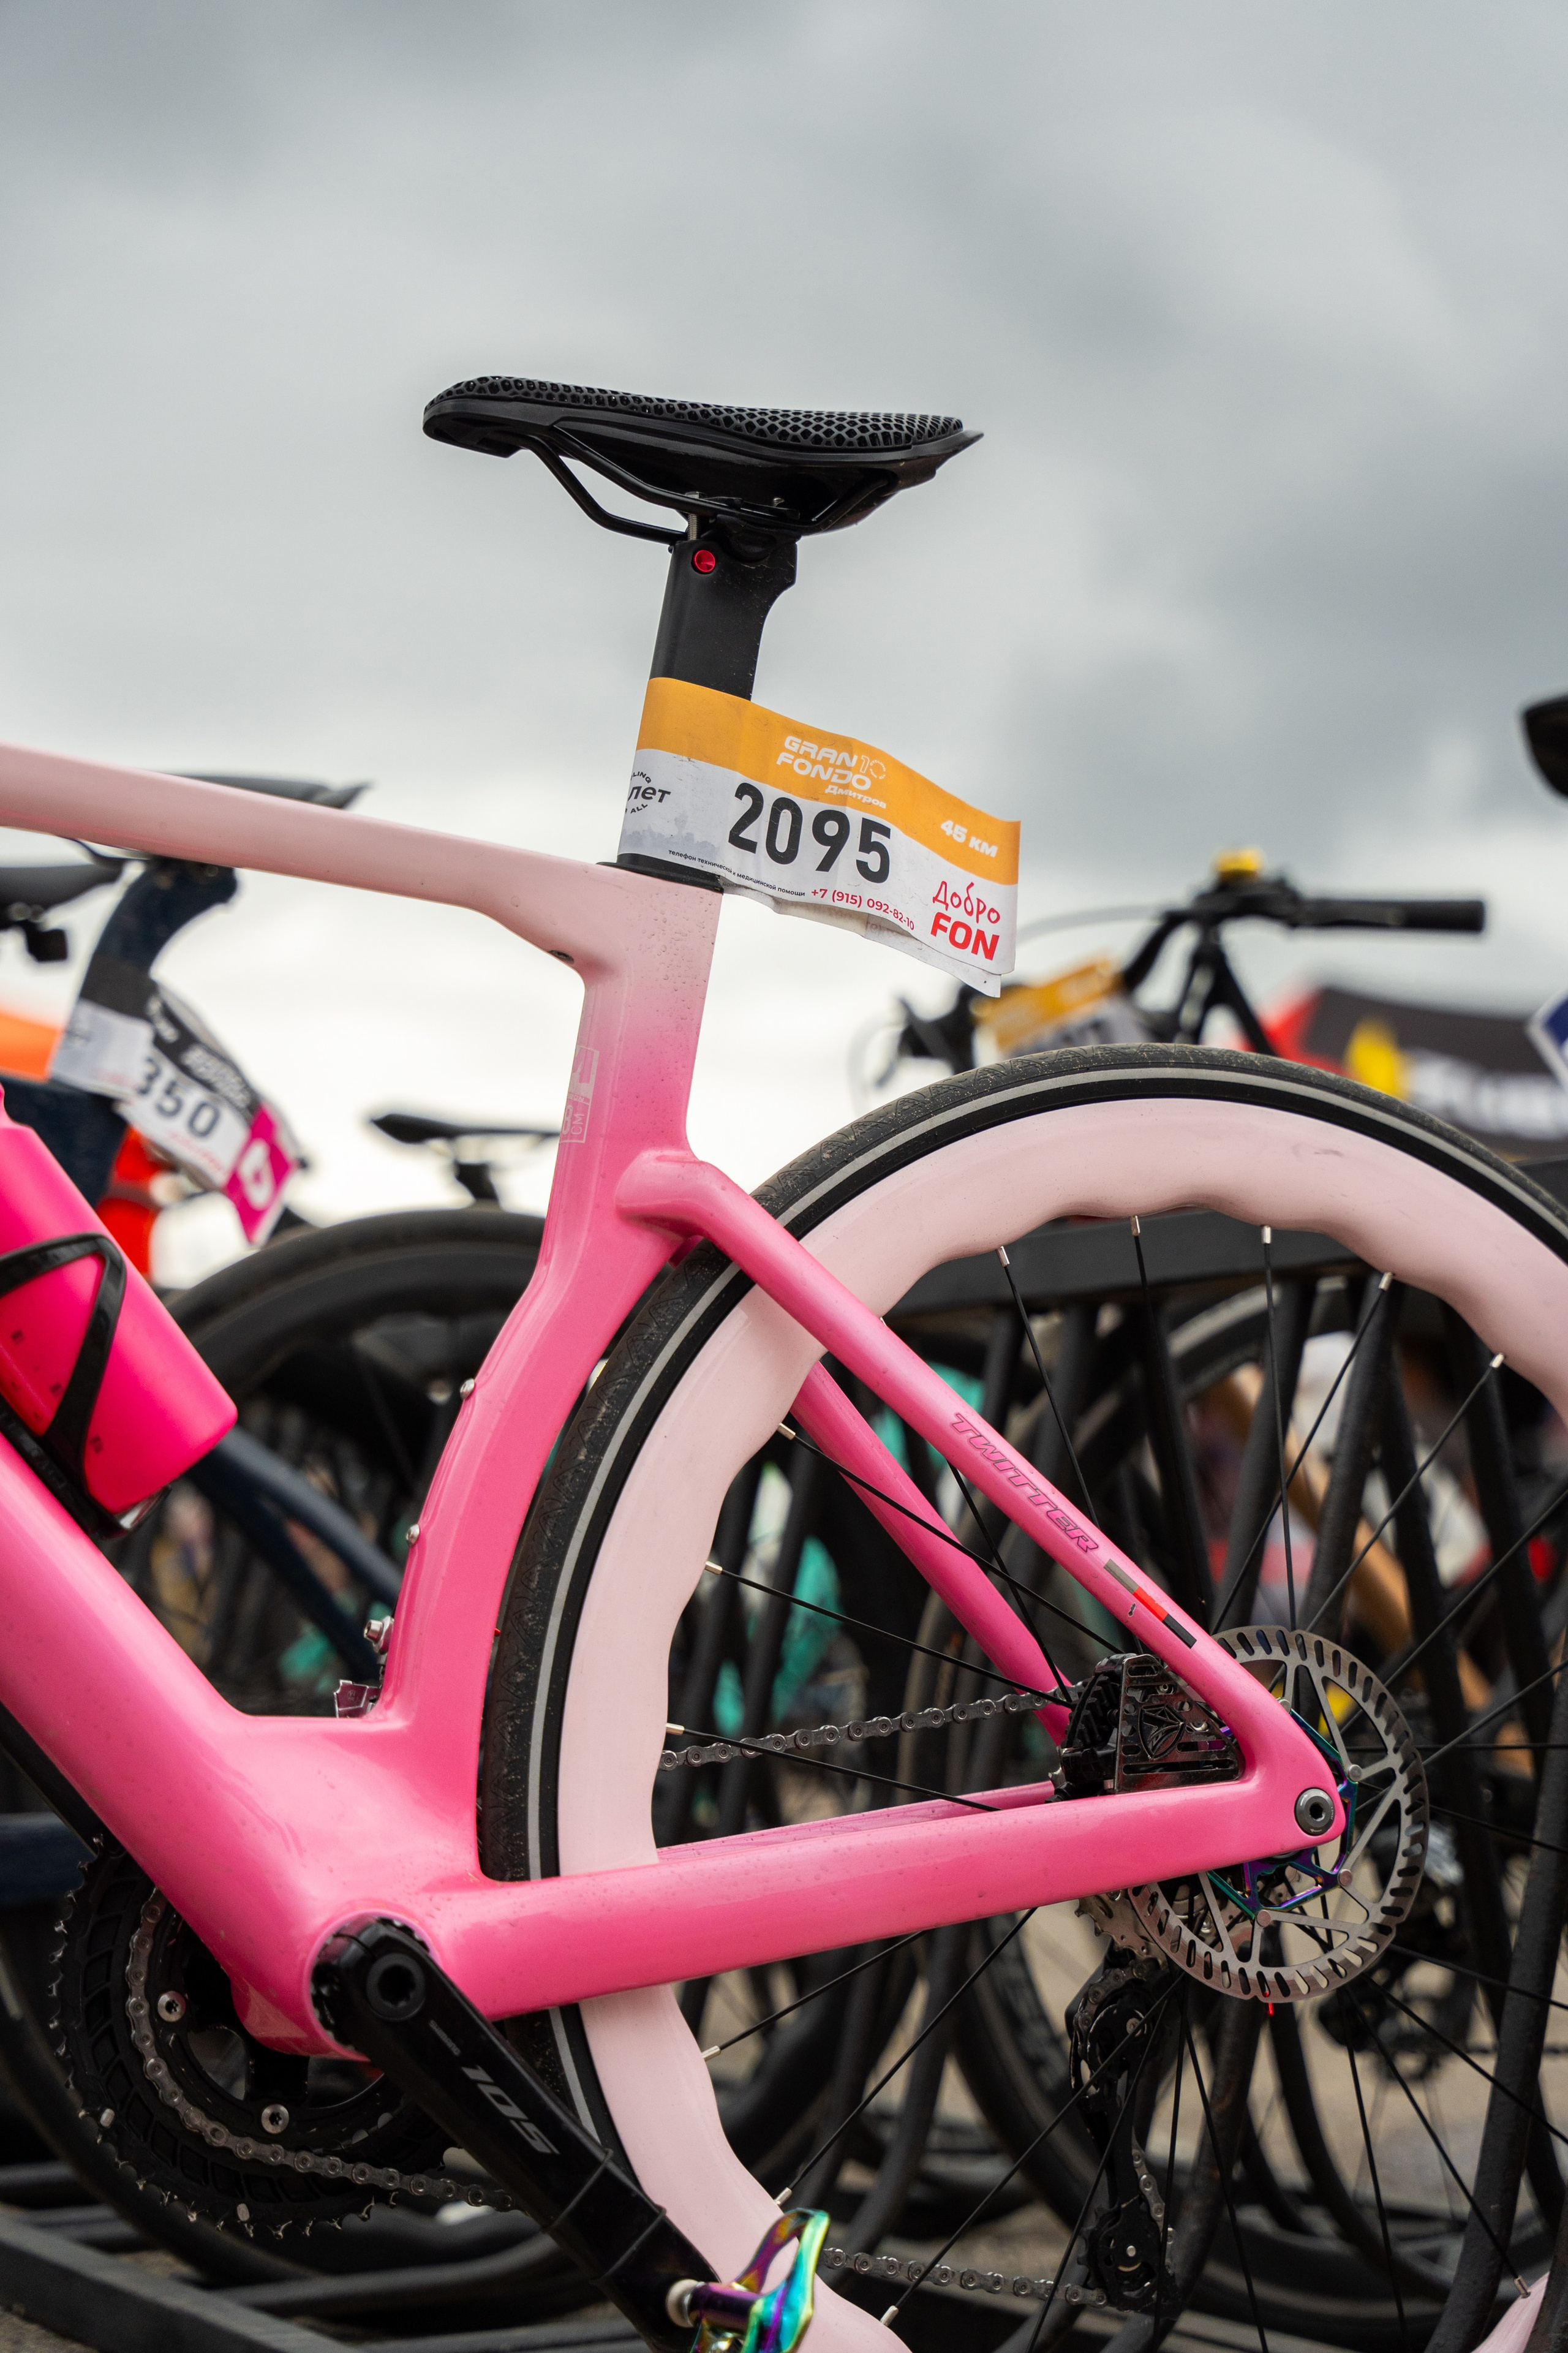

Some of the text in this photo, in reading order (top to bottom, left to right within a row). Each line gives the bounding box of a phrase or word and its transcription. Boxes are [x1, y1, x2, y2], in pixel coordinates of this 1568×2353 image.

[777, 752, 871, 790] FONDO
[785, 736, 858, 767] GRAN
[825, 785, 886, 809] Дмитров
[728, 782, 891, 883] 2095
[940, 820, 968, 843] 45
[668, 850, 696, 861] телефон
[697, 858, 733, 874] технической
[737, 874, 776, 891] медицинской
[778, 886, 805, 897] помощи
[812, 888, 827, 899] +7
[832, 889, 862, 908] (915)
[867, 898, 914, 931] 092-82-10
[932, 880, 1001, 924] Добро
[930, 912, 1000, 961] FON
[135, 1056, 222, 1139] 350
[571, 1114, 585, 1135] CM
[951, 1413, 1099, 1553] TWITTER
[461, 2064, 560, 2155] 105
